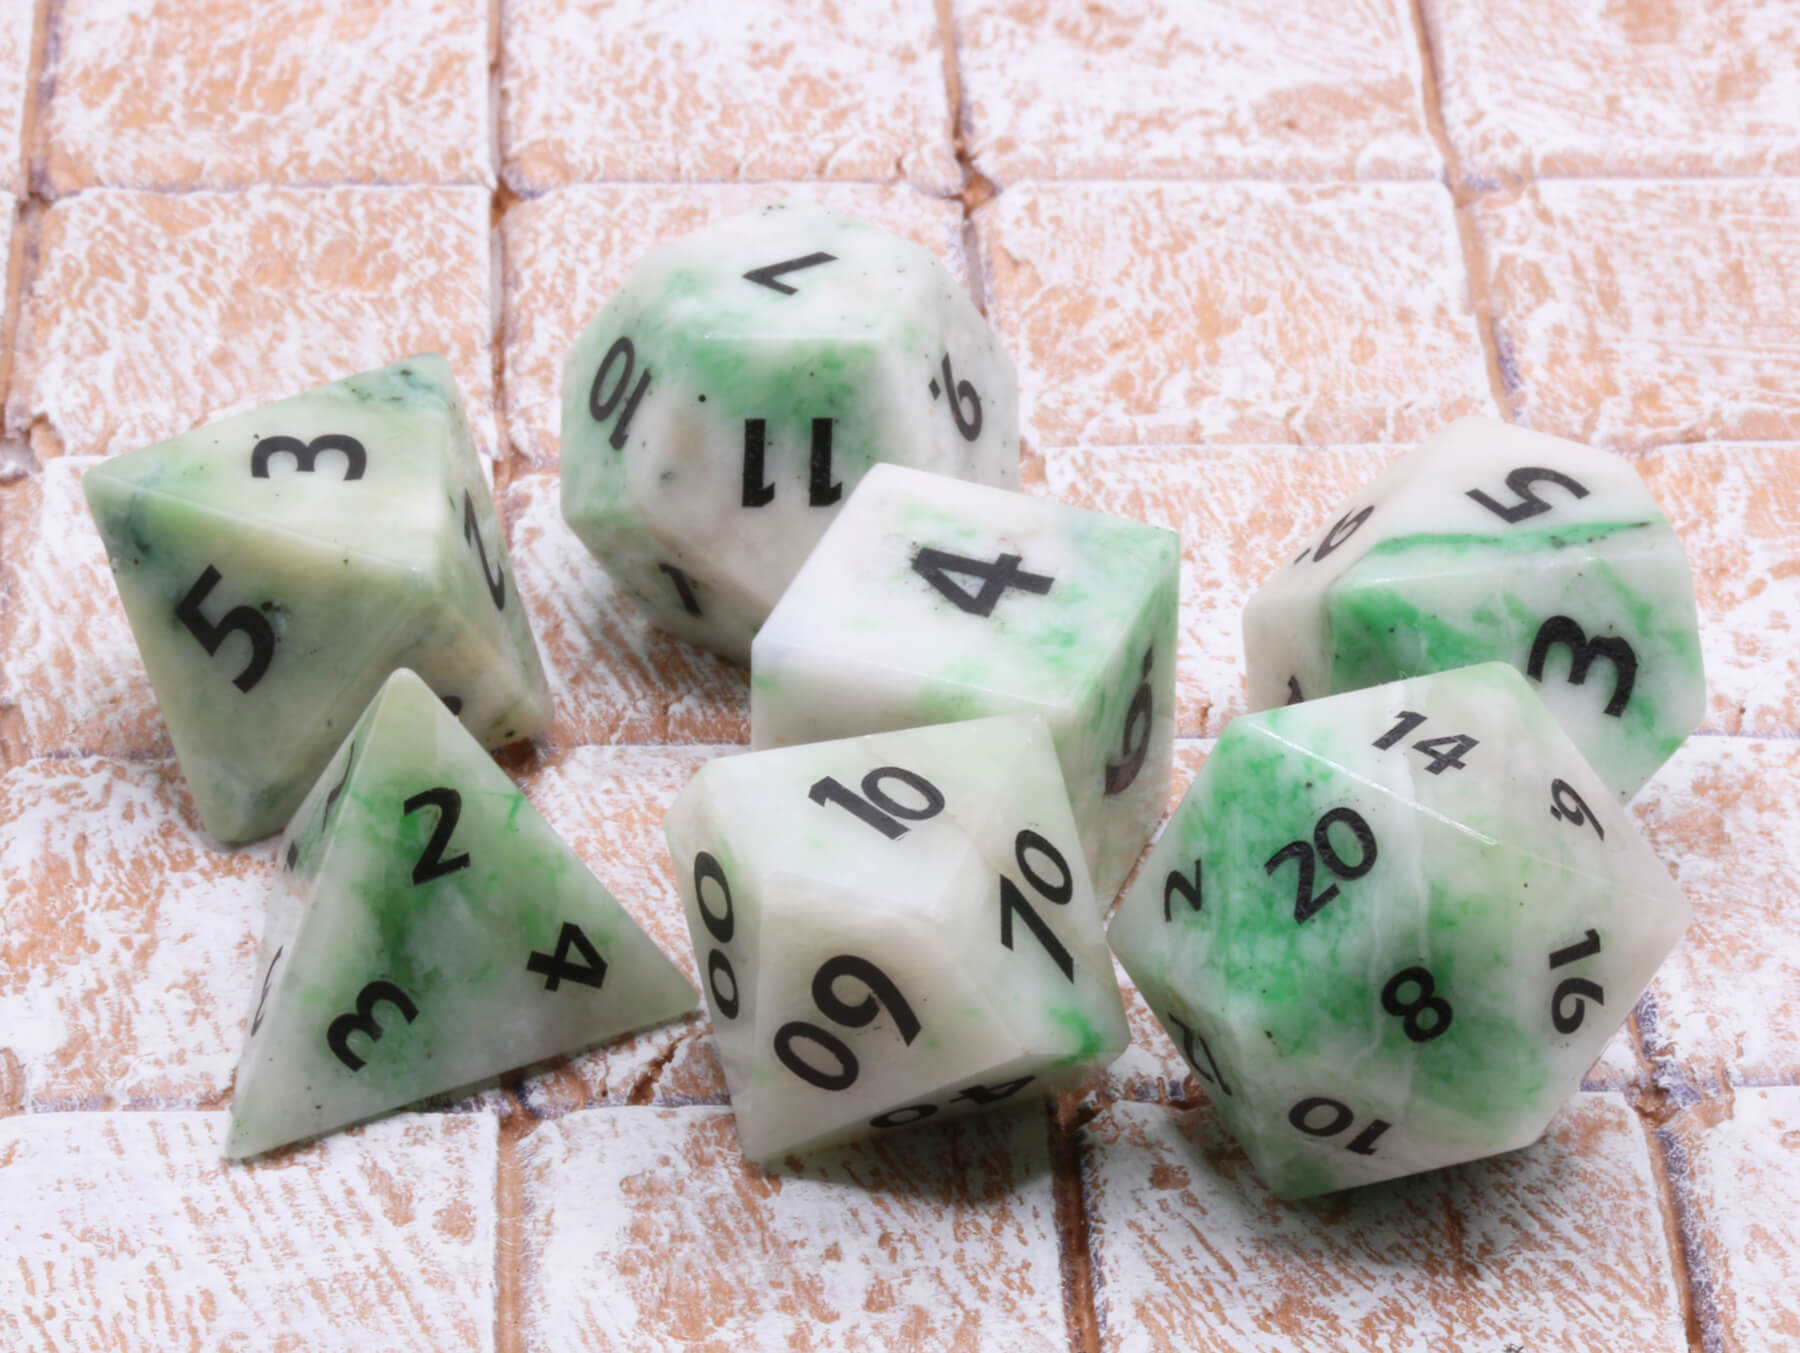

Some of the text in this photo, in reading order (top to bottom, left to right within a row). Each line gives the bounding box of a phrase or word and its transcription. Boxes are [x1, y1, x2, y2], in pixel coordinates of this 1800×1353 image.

[743, 251, 838, 295] 7
[589, 335, 652, 451] 10
[251, 434, 366, 480] 3
[742, 418, 842, 507] 11
[1465, 467, 1589, 524] 5
[910, 547, 1054, 618] 4
[174, 564, 276, 694] 5
[1527, 615, 1638, 717] 3
[1372, 711, 1479, 774] 14
[403, 787, 470, 886] 2
[808, 766, 945, 840] 10
[1164, 859, 1202, 922] 2
[1264, 808, 1377, 924] 20
[1000, 829, 1073, 984] 70
[526, 922, 608, 992] 4
[1549, 929, 1604, 1034] 16
[327, 980, 419, 1072] 3
[1380, 966, 1453, 1043] 8
[1288, 1097, 1392, 1156] 10
